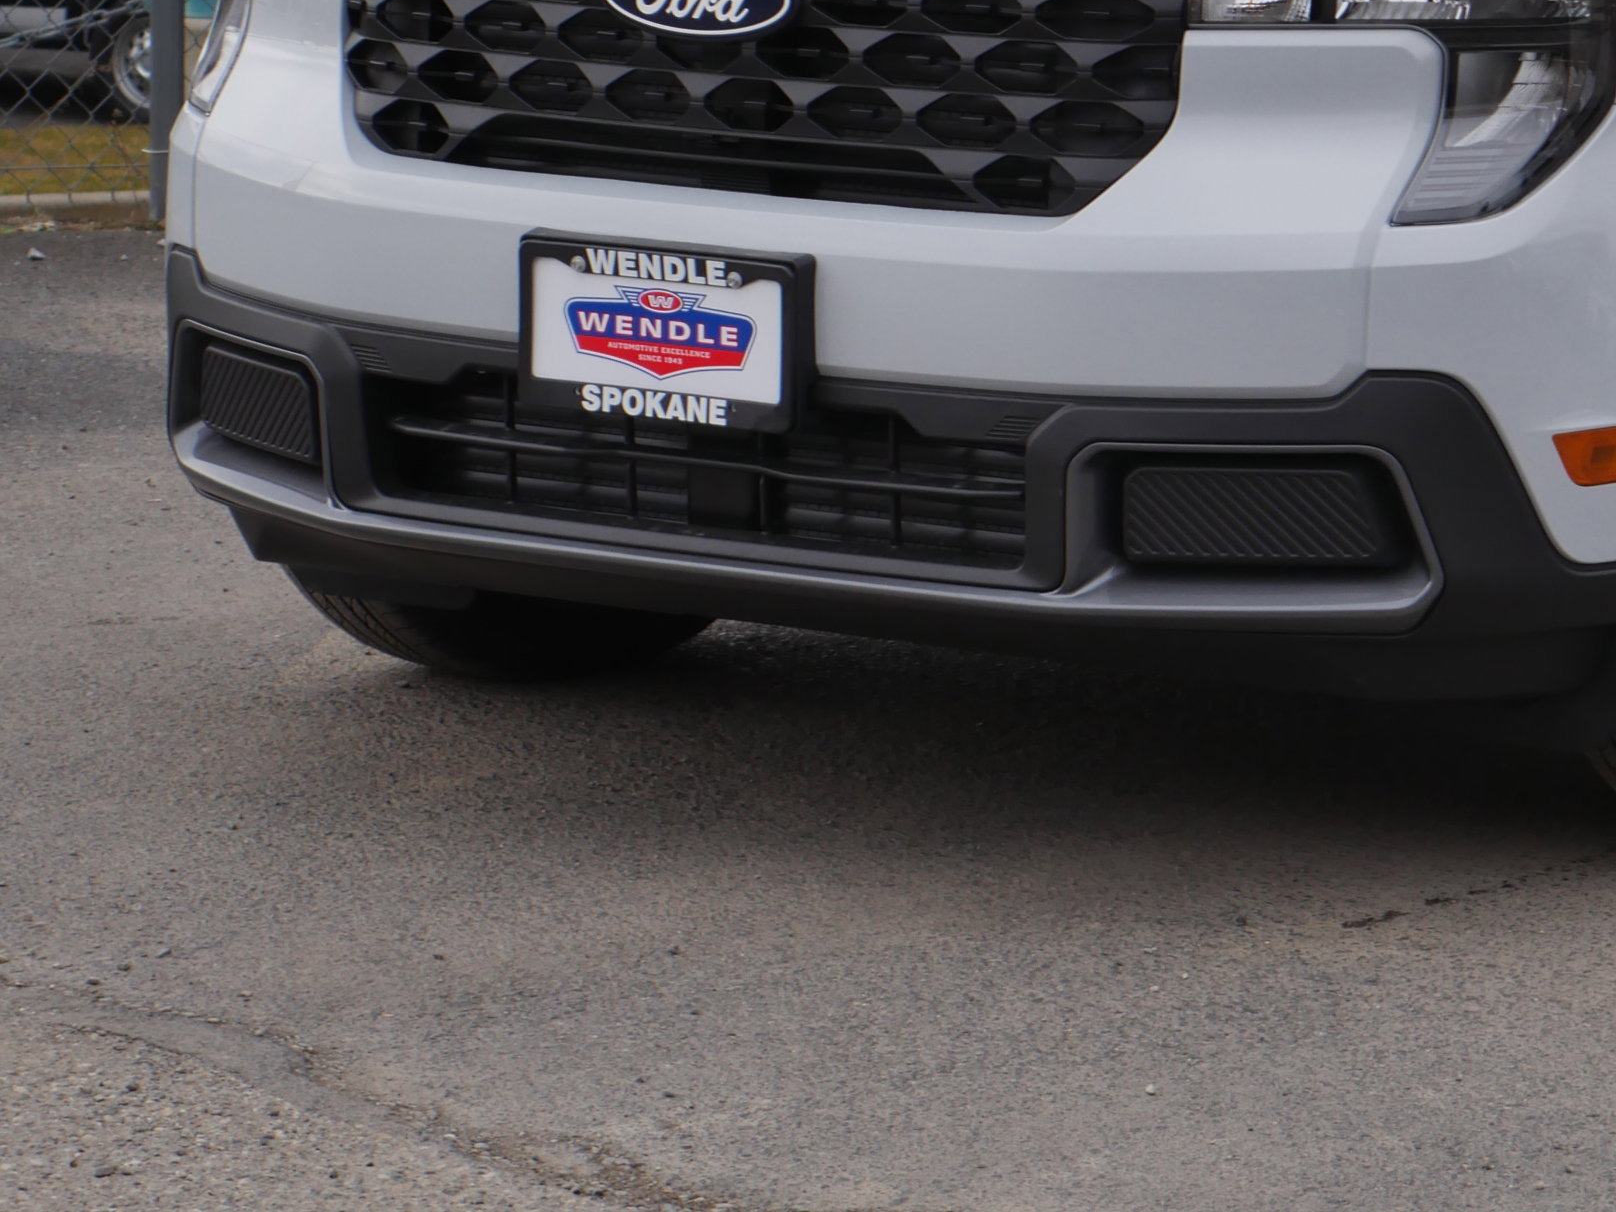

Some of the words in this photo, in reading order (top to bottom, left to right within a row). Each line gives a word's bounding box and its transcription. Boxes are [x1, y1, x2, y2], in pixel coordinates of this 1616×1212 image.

[585, 248, 727, 287] WENDLE
[576, 310, 739, 347] WENDLE
[607, 341, 659, 353] AUTOMOTIVE
[661, 346, 711, 359] EXCELLENCE
[638, 353, 662, 363] SINCE
[664, 356, 683, 365] 1943
[580, 384, 728, 426] SPOKANE
